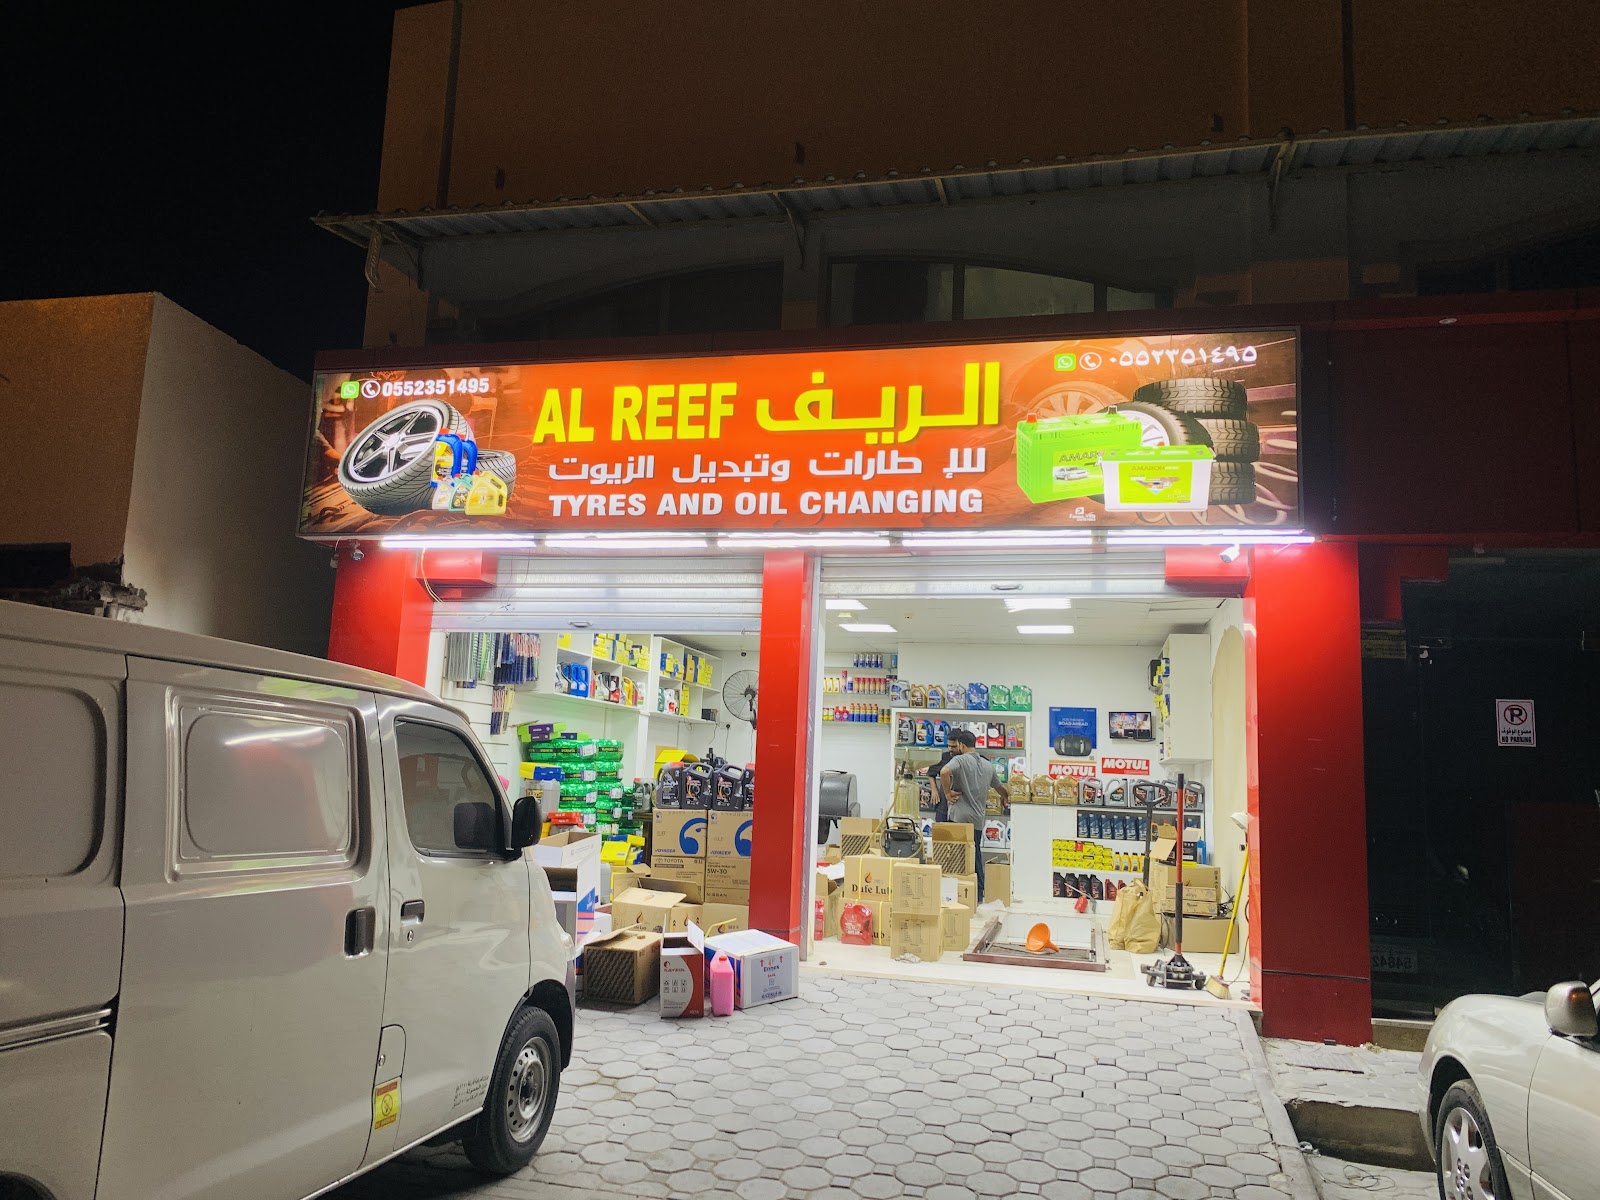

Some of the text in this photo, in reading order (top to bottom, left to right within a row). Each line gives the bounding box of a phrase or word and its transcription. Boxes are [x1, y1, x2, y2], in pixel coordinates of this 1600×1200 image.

[382, 377, 489, 397] 0552351495
[533, 382, 737, 443] AL REEF
[755, 361, 1000, 445] الريف
[549, 455, 654, 485] الزيوت
[672, 453, 790, 483] وتبديل
[549, 487, 983, 518] TYRES AND OIL CHANGING
[1050, 765, 1096, 778] MOTUL
[1103, 758, 1149, 770] MOTUL
